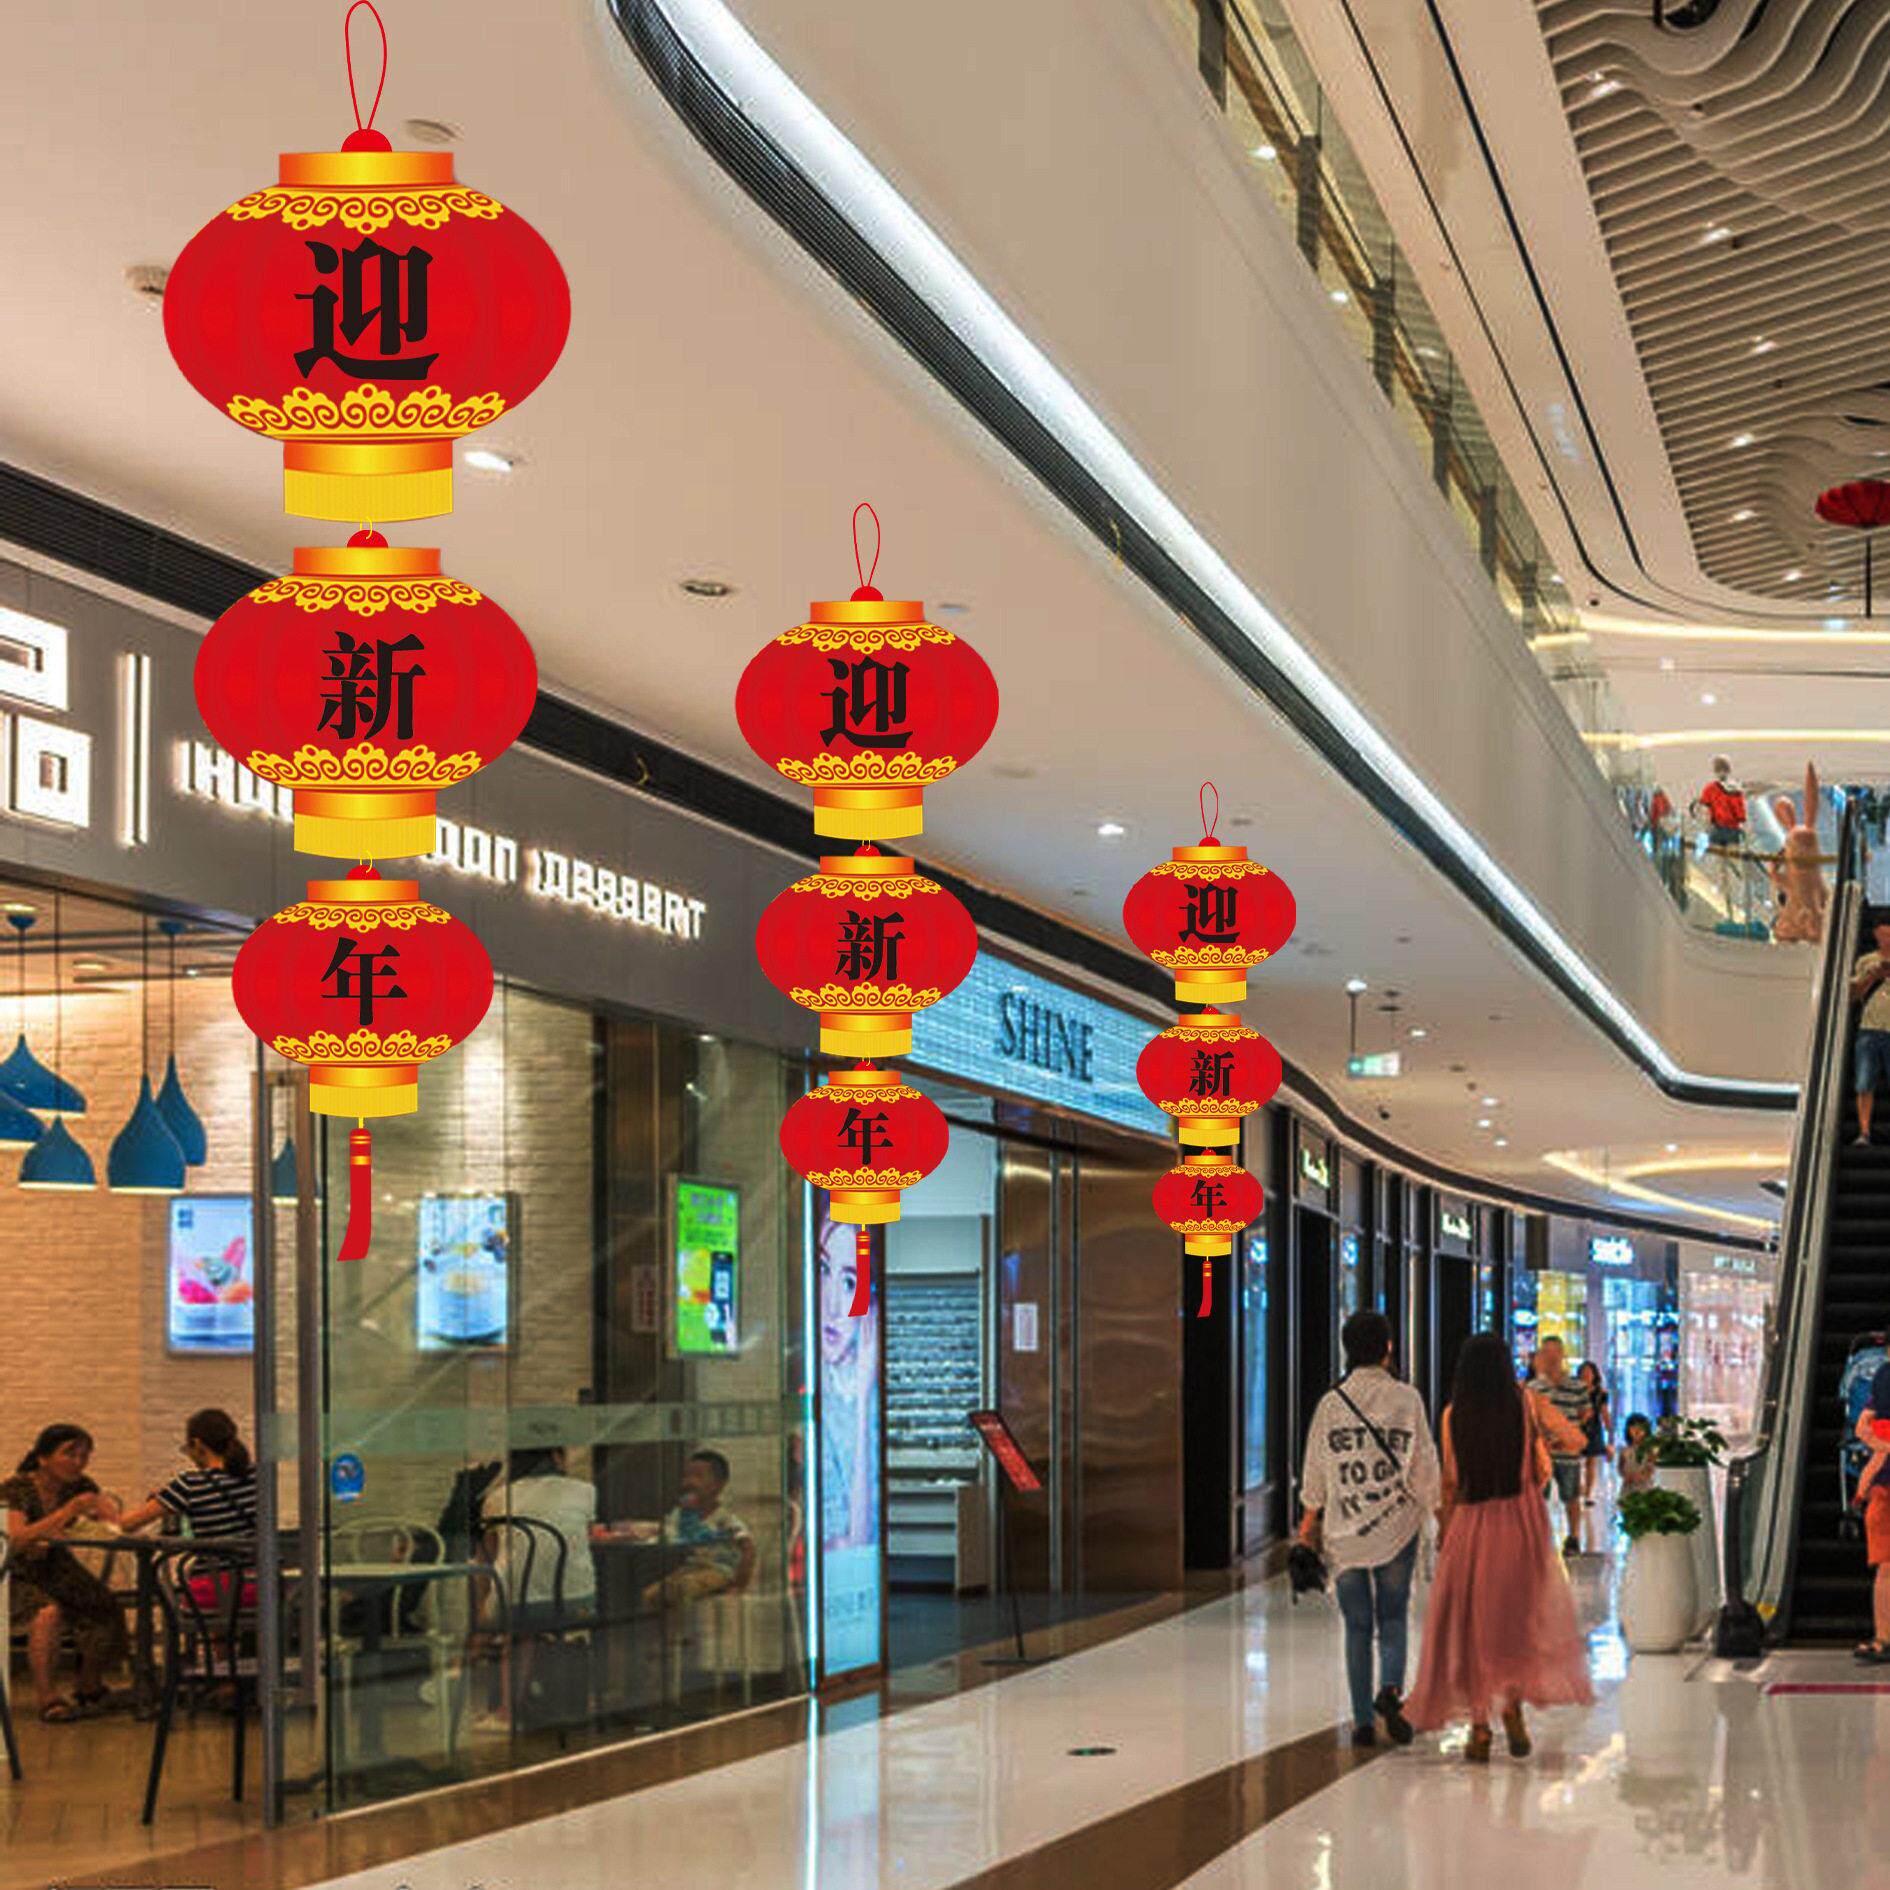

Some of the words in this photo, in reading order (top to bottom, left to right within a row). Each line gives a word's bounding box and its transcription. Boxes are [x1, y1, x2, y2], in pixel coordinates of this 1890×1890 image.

[294, 238, 439, 381] 迎
[318, 631, 426, 740] 新
[819, 656, 913, 749] 迎
[836, 910, 905, 981] 新
[1179, 883, 1240, 943] 迎
[321, 937, 407, 1026] 年
[1000, 990, 1093, 1083] SHINE
[1189, 1050, 1235, 1097] 新
[837, 1107, 893, 1165] 年
[1191, 1179, 1227, 1217] 年
[1327, 1426, 1367, 1453] GET
